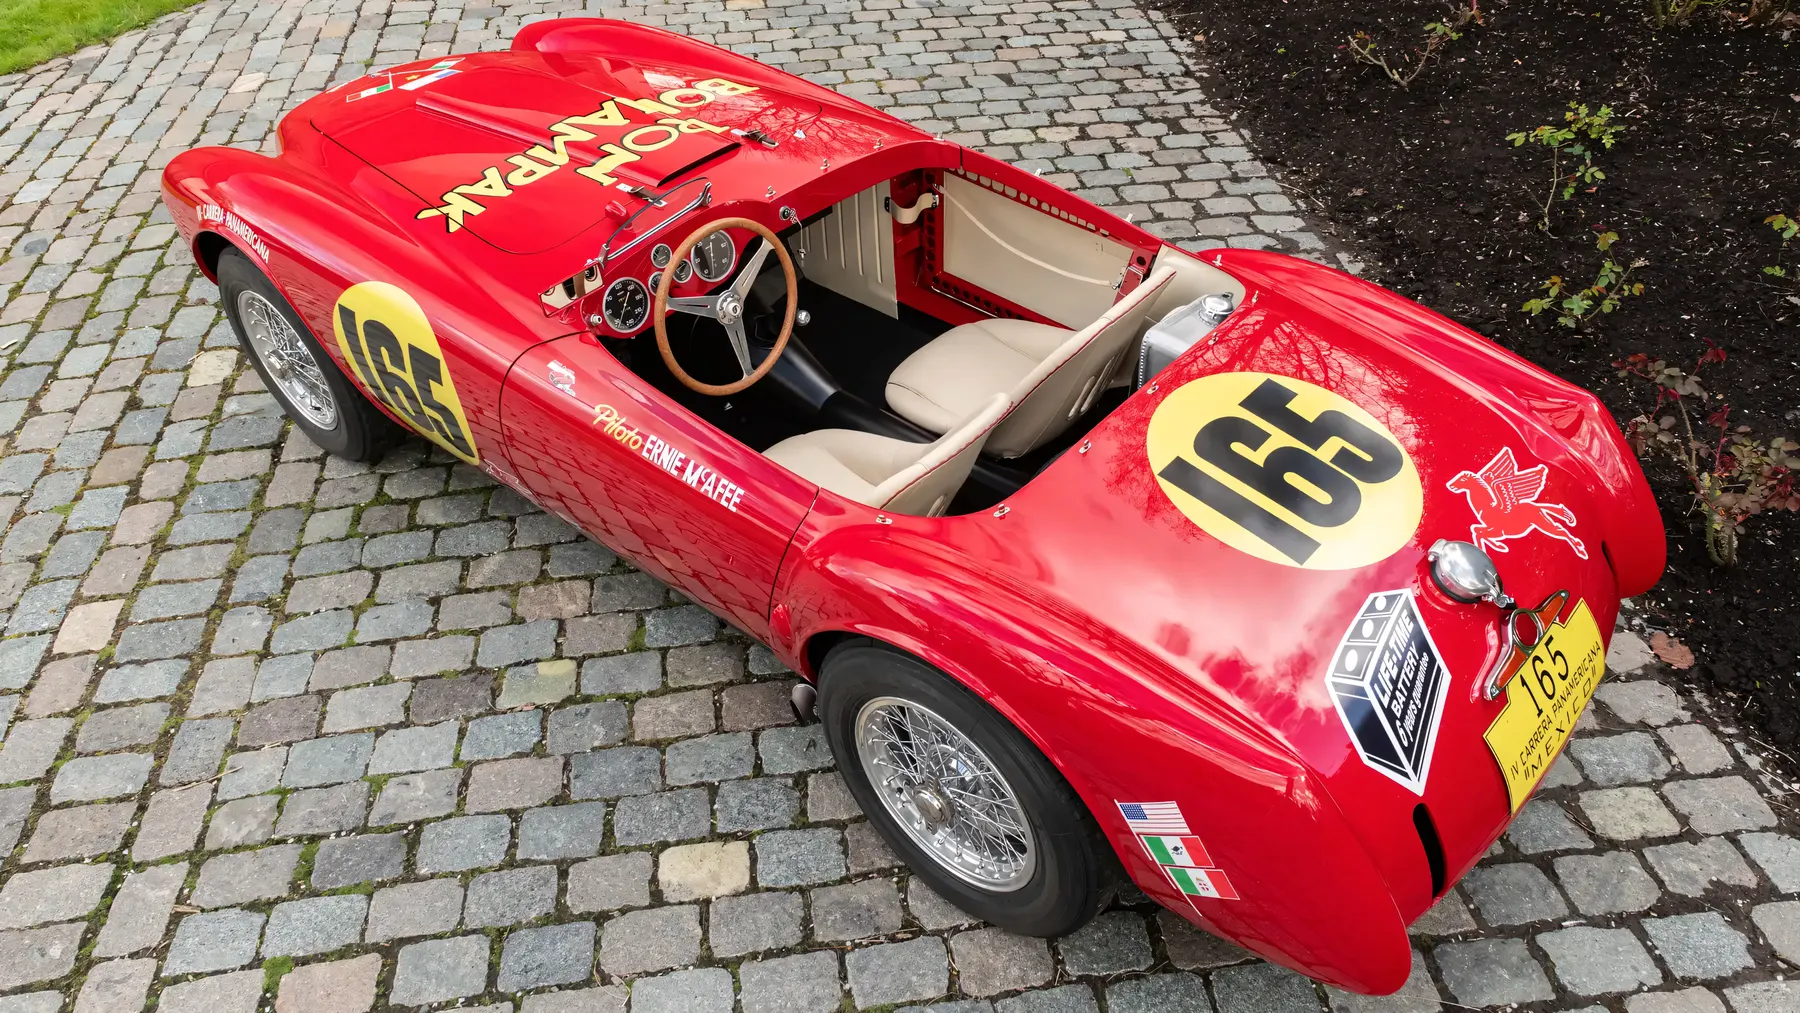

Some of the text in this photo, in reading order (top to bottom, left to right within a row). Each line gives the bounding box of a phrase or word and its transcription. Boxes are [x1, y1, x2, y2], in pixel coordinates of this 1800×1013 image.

[338, 303, 476, 458] 165
[593, 404, 643, 450] Piloto
[642, 434, 686, 477] ERNIE
[1157, 378, 1404, 566] 165
[1374, 609, 1415, 709] LIFE-TIME
[1391, 641, 1420, 718] BATTERY
[1395, 652, 1430, 747] 6 years guarantee
[1520, 635, 1569, 719] 165
[1510, 640, 1602, 781] IV CARRERA PANAMERICANA
